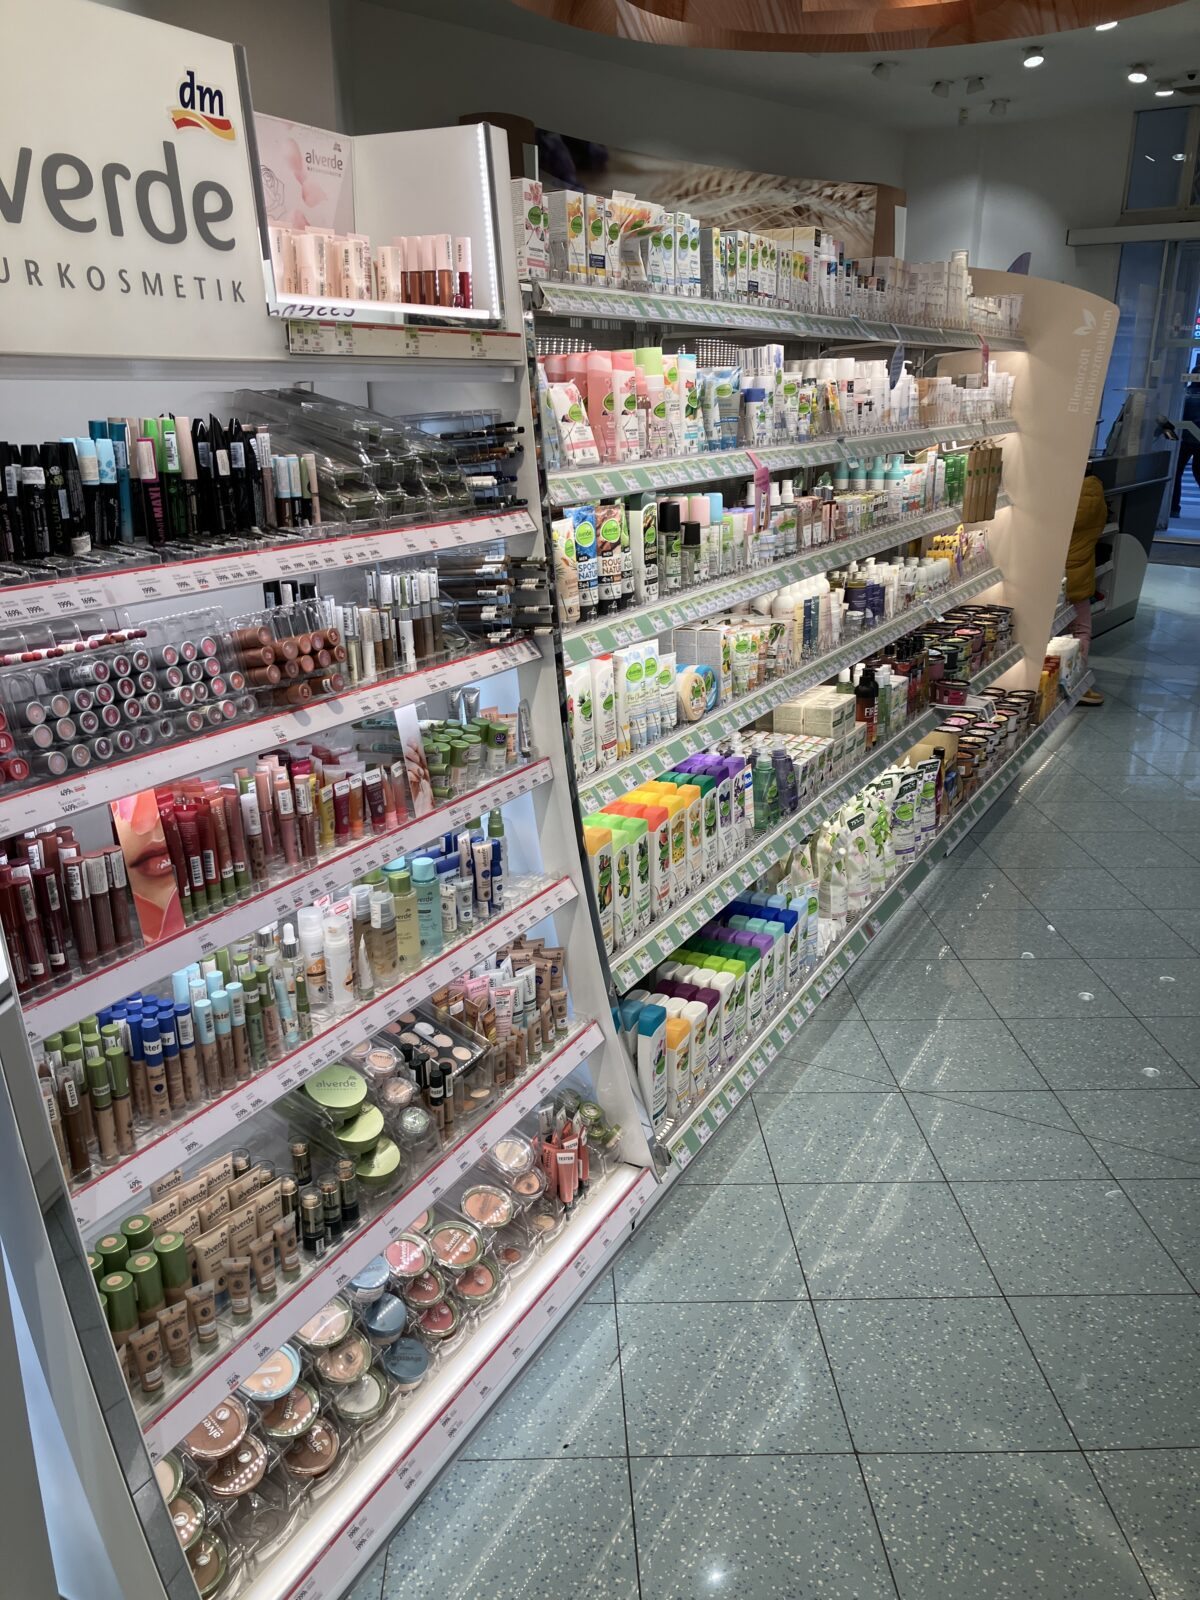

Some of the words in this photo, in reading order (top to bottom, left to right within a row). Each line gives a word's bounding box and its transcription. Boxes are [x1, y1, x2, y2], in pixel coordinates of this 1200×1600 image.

[179, 70, 224, 117] dm
[305, 149, 343, 171] alverde
[316, 1080, 357, 1089] alverde
[157, 1173, 182, 1192] alverde
[208, 1167, 231, 1187] alverde
[181, 1188, 207, 1207] alverde
[237, 1180, 261, 1200] alverde
[207, 1200, 229, 1221] alverde
[258, 1195, 281, 1214] alverde
[152, 1208, 177, 1227] alverde
[230, 1215, 255, 1234] alverde
[204, 1237, 228, 1258] alverde
